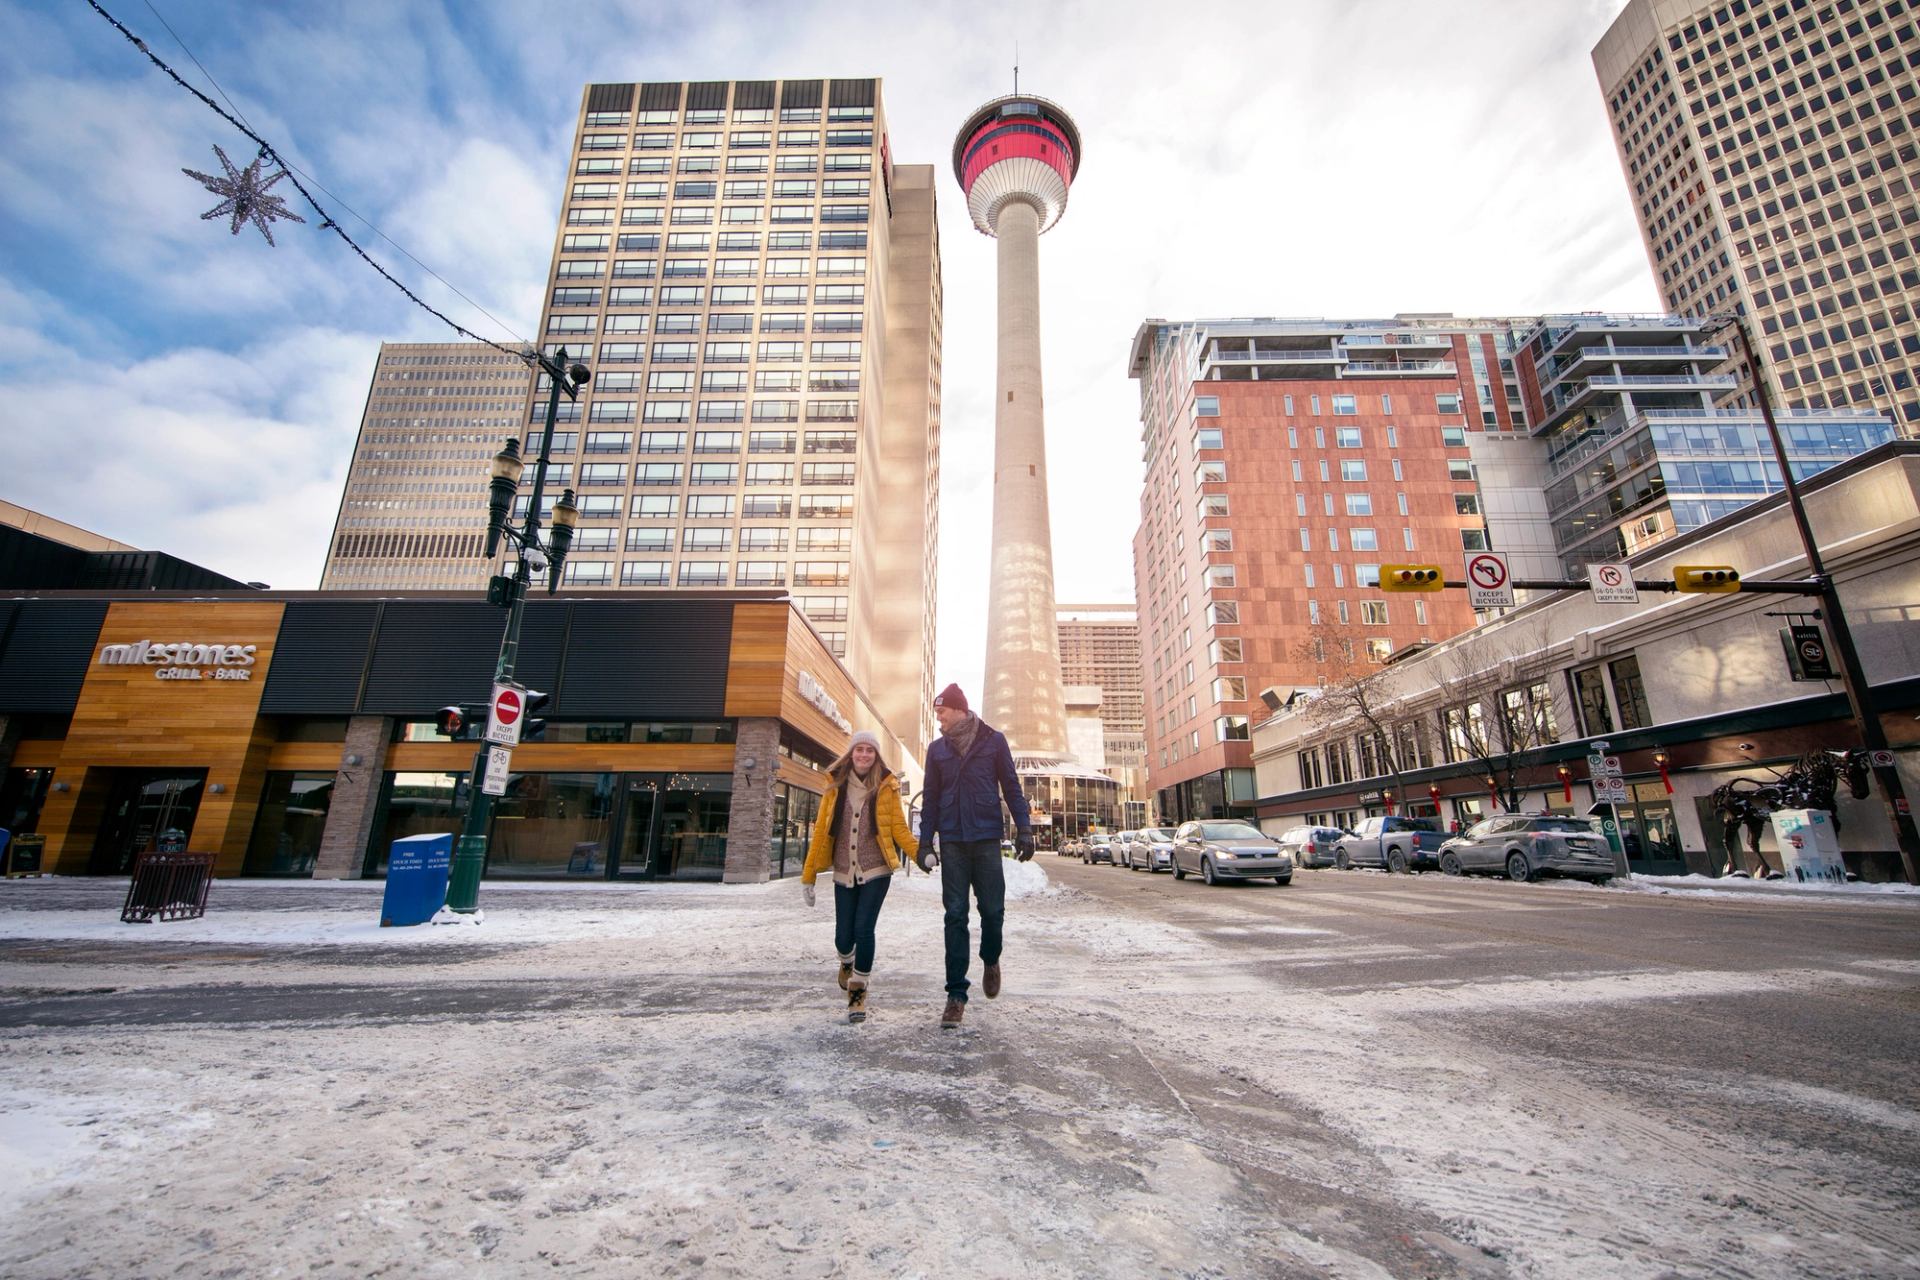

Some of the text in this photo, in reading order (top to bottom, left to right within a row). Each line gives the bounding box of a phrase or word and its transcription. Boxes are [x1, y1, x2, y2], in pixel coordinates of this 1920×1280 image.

[1475, 597, 1509, 605] BICYCLES
[98, 639, 257, 665] milestones
[155, 667, 251, 681] GRILL BAR
[496, 725, 513, 734] EXCEPT
[492, 732, 515, 741] BICYCLES
